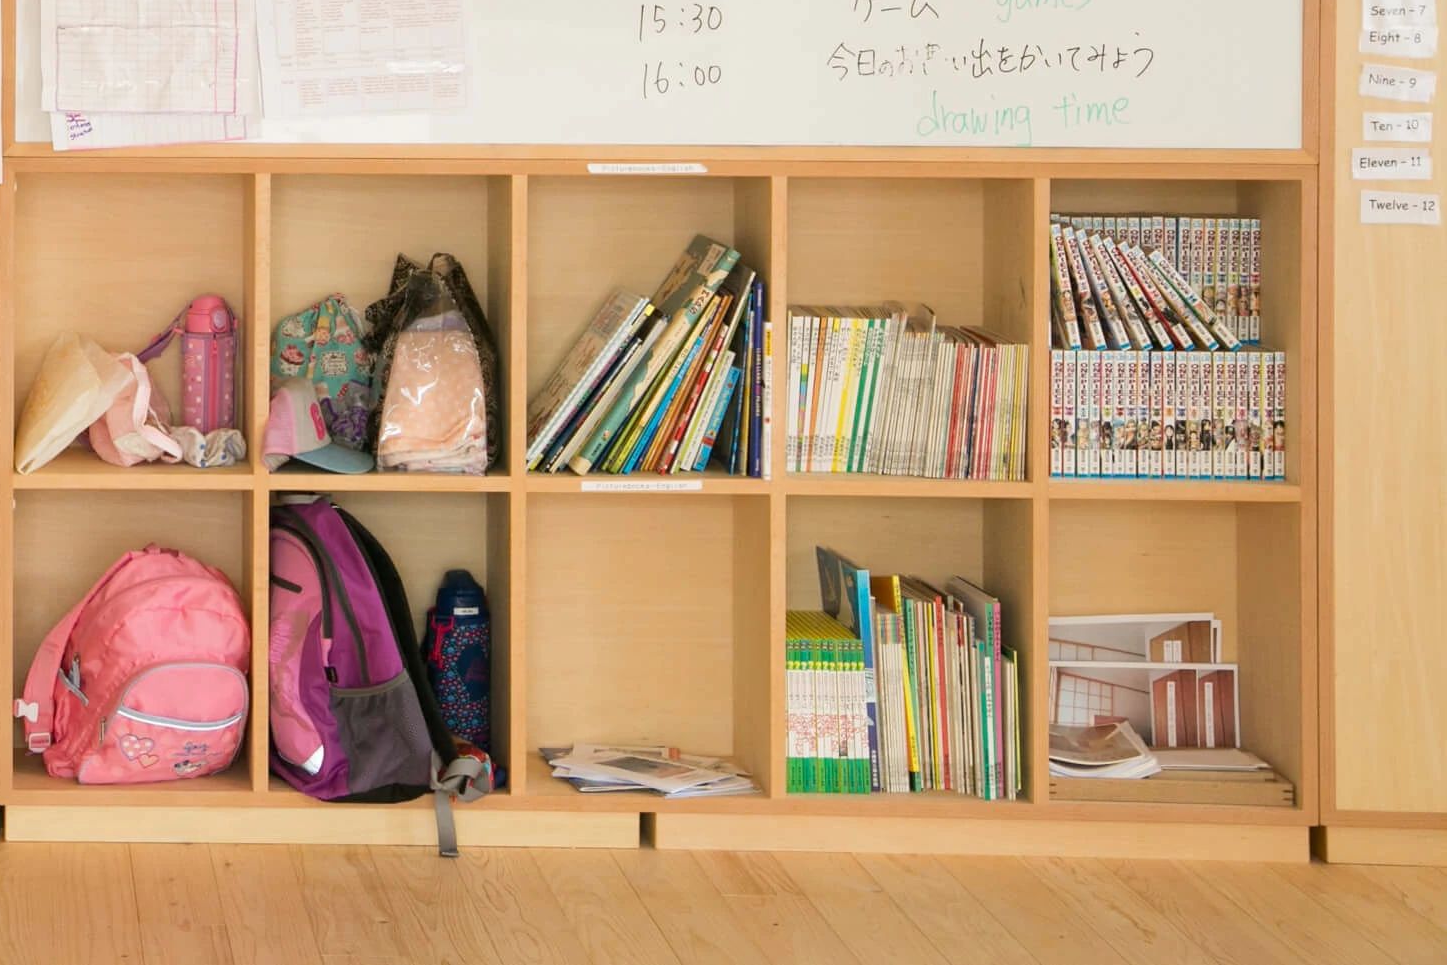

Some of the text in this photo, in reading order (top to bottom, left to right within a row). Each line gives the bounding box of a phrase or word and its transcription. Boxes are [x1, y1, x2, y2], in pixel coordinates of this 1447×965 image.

[1369, 4, 1426, 16] Seven 7
[638, 2, 723, 42] 15:30
[1369, 30, 1422, 45] Eight 8
[642, 60, 722, 100] 16:00
[1368, 73, 1417, 88] Nine 9
[916, 90, 1131, 147] drawing time
[1370, 119, 1420, 132] Ten 10
[1359, 156, 1421, 169] Eleven 11
[1368, 199, 1436, 212] Twelve 12
